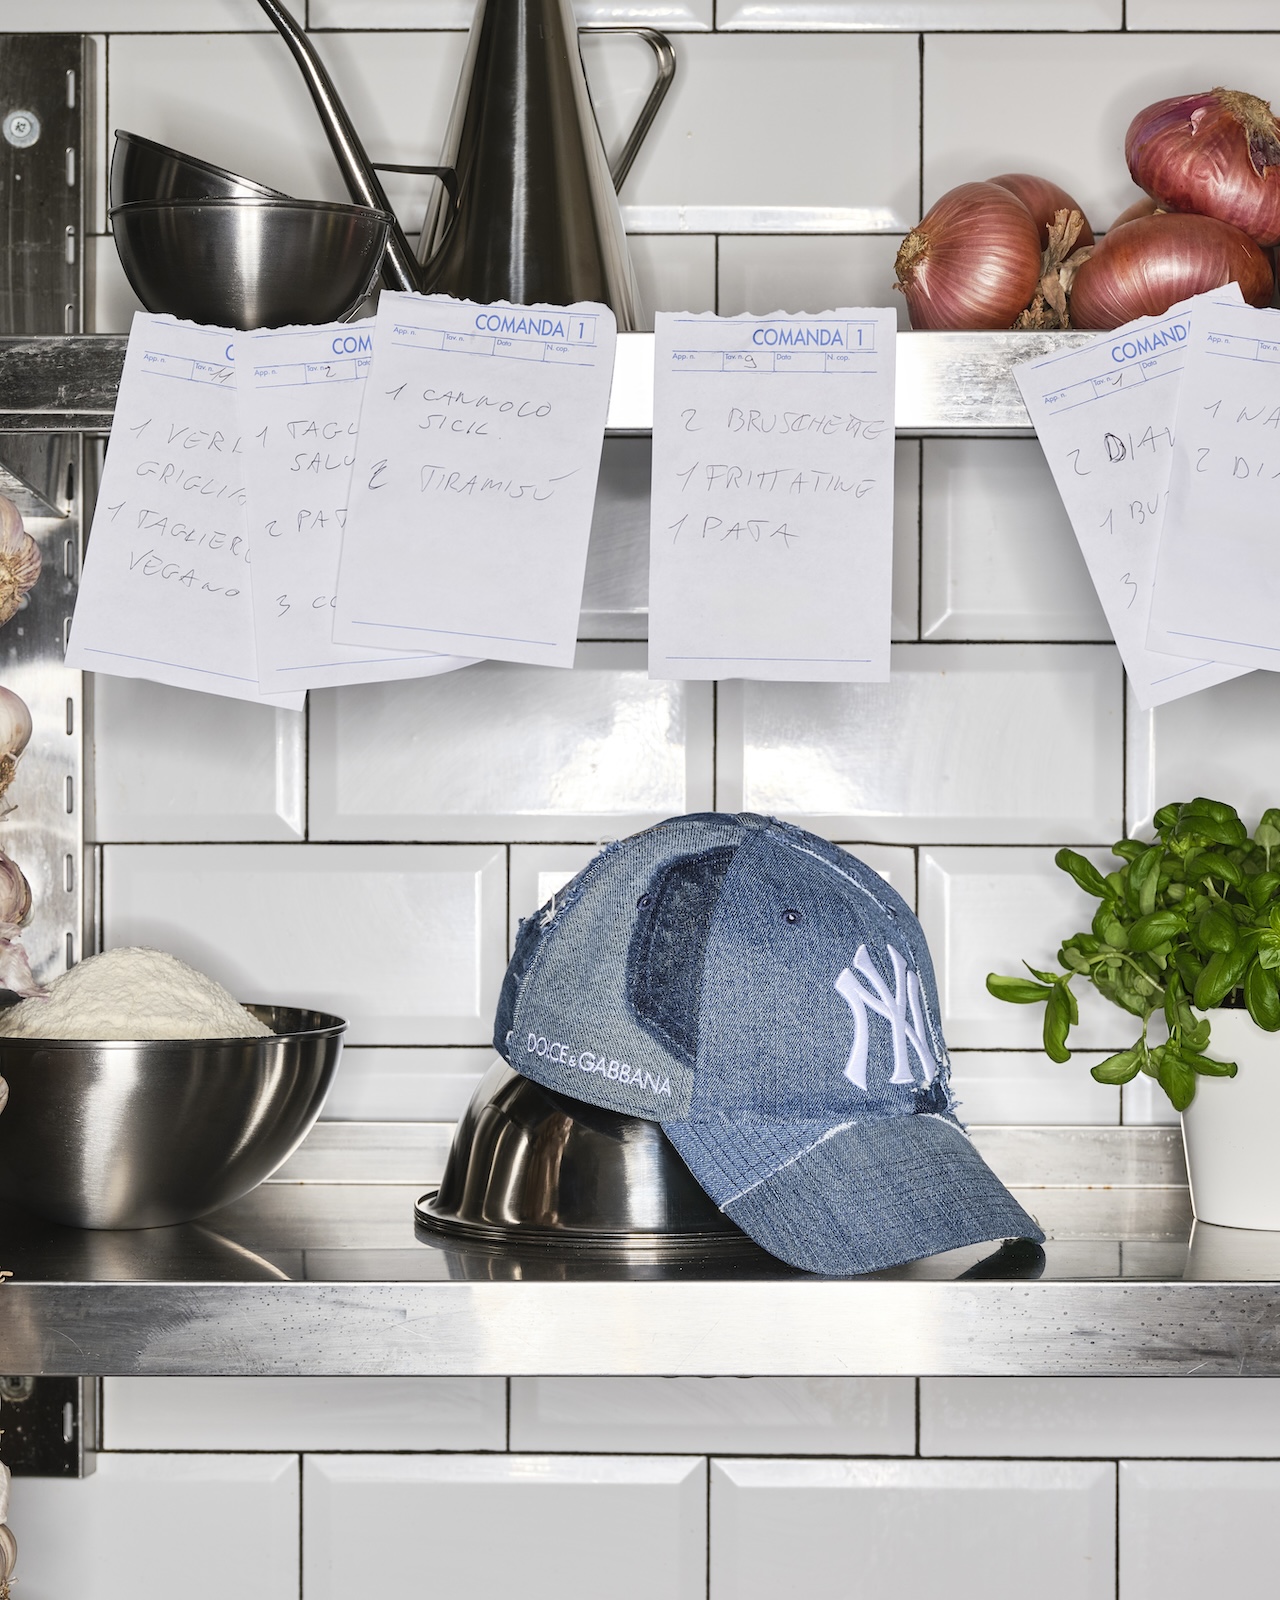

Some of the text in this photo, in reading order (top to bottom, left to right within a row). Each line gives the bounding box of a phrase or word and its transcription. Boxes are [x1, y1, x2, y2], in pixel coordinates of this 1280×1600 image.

[393, 326, 410, 337] App.
[475, 313, 586, 339] COMANDA 1
[446, 333, 458, 341] Tav.
[497, 339, 512, 347] Data
[752, 328, 863, 346] COMANDA 1
[1207, 335, 1222, 344] App.
[1260, 342, 1272, 350] Tav.
[143, 353, 158, 363] App.
[672, 353, 689, 362] App.
[725, 353, 737, 361] Tav.
[195, 362, 207, 371] Tav.
[1141, 360, 1158, 369] Data
[1093, 378, 1107, 387] Tav.
[385, 383, 408, 401] 1
[1044, 395, 1059, 405] App.
[1203, 399, 1223, 419] 1
[680, 408, 703, 432] 2
[130, 418, 152, 439] 1
[255, 425, 269, 449] 1
[676, 462, 700, 493] 1
[107, 501, 127, 523] 1
[1099, 508, 1113, 535] 1
[668, 513, 689, 545] 1
[834, 943, 938, 1092] NY
